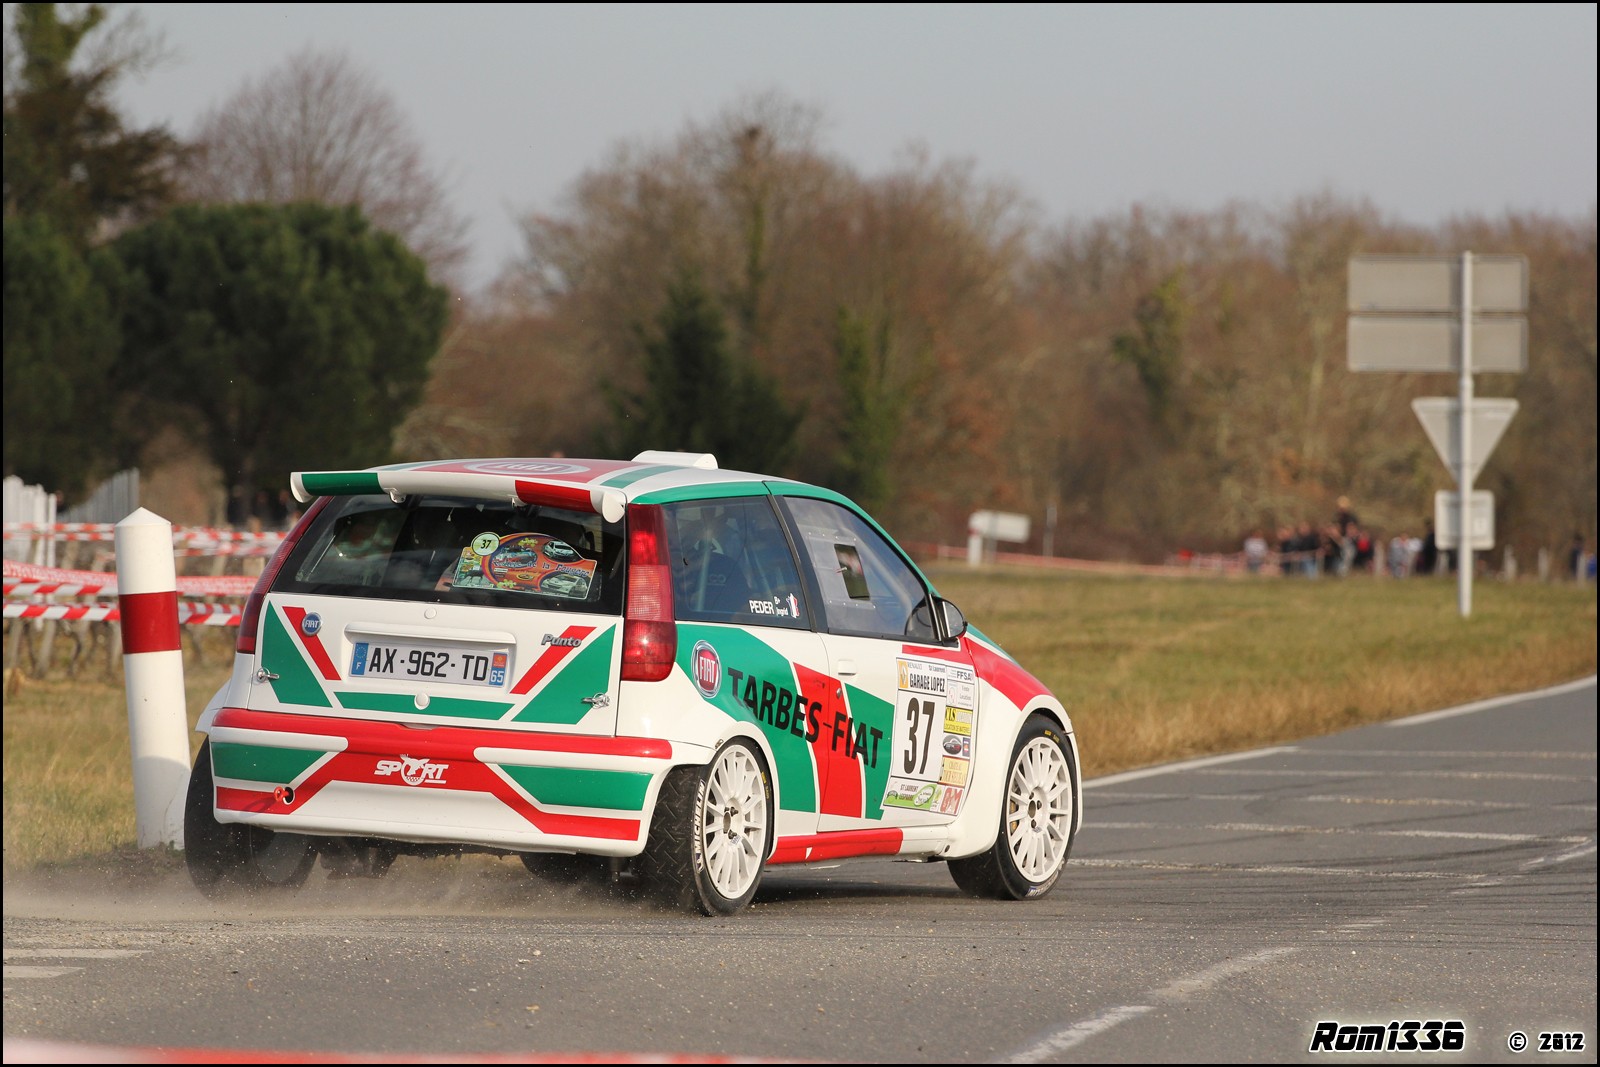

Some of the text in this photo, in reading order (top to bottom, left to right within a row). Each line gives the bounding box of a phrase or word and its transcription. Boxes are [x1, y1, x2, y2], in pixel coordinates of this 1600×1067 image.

[480, 540, 492, 550] 37
[749, 600, 775, 615] PEDER
[304, 618, 320, 630] FIAT
[541, 633, 582, 648] Punto
[356, 647, 504, 685] F AX-962-TD 65
[699, 656, 717, 684] FIAT
[909, 673, 946, 693] GARAGE LOPEZ
[903, 697, 936, 775] 37
[692, 778, 706, 854] MICHELIN
